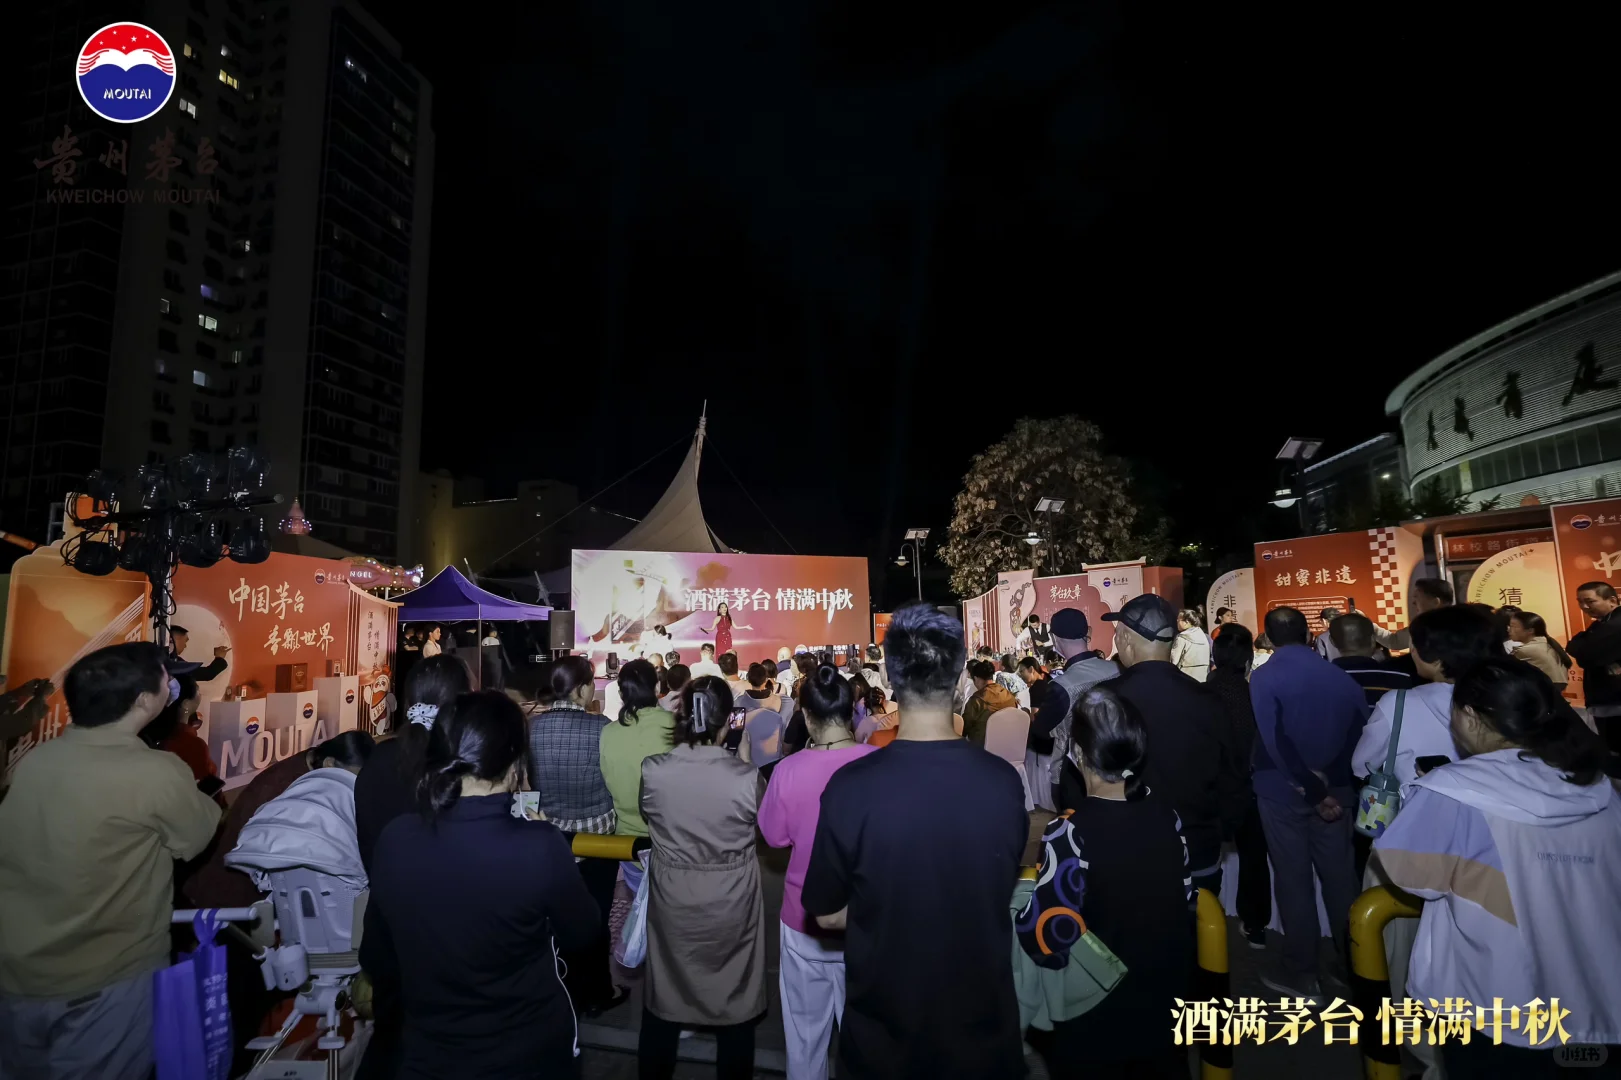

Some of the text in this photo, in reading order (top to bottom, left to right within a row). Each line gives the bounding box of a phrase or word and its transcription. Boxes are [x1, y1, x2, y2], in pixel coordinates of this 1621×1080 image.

[228, 577, 305, 622] 中国茅台
[684, 587, 854, 624] 酒满茅台 情满中秋
[1498, 587, 1524, 606] 猜
